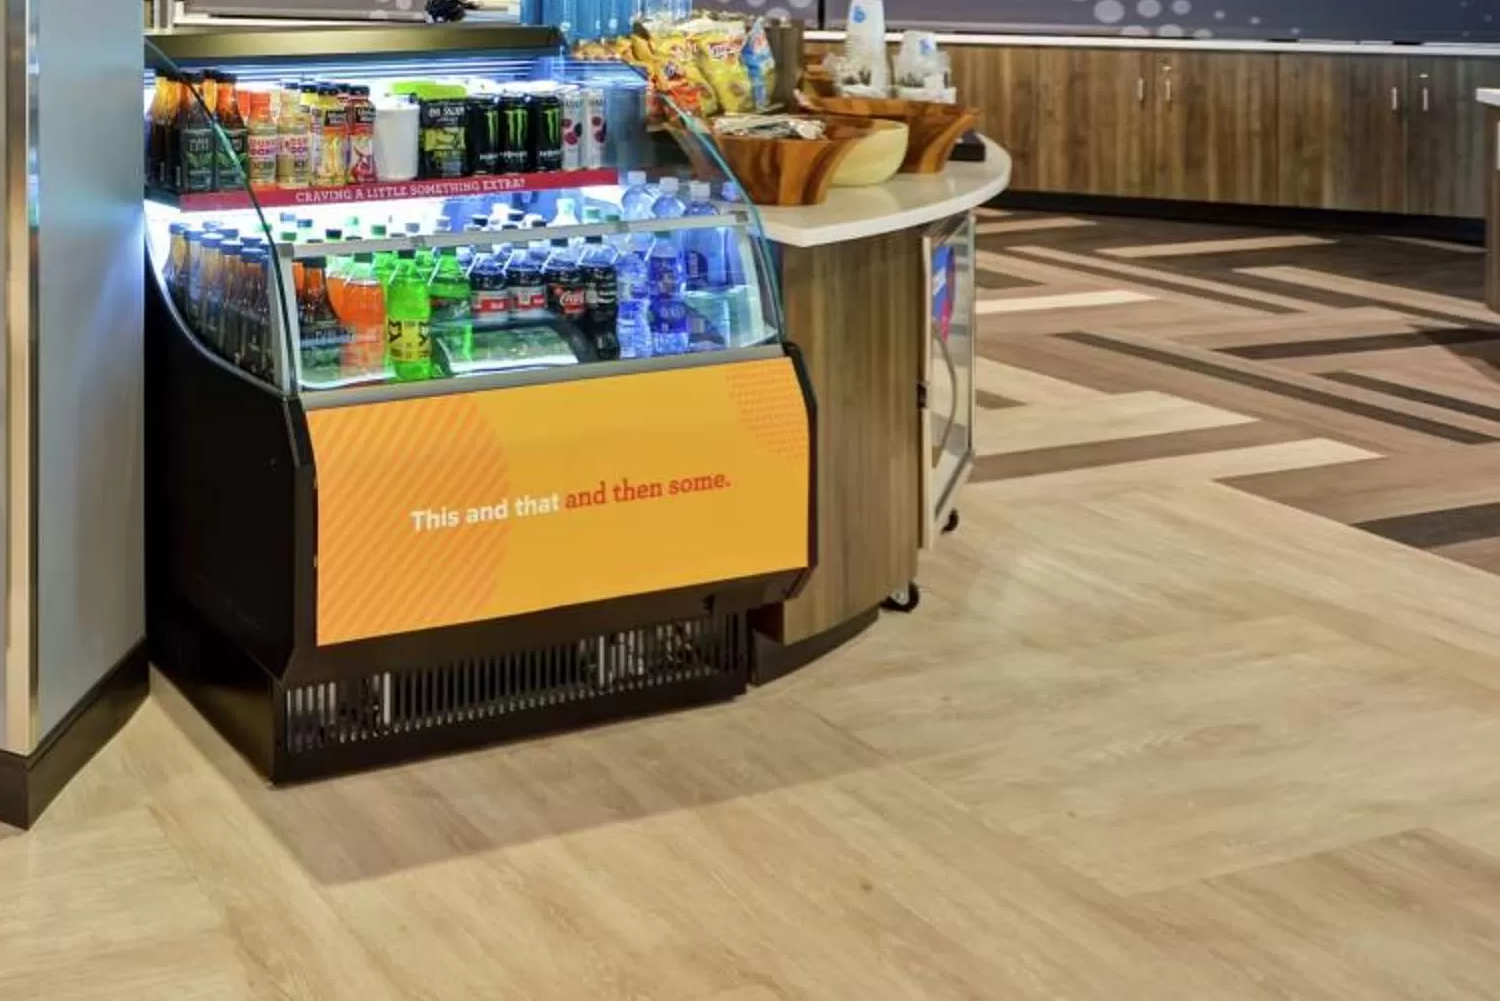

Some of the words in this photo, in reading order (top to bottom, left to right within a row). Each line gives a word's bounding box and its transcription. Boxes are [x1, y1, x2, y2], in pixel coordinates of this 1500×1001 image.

[295, 189, 351, 204] CRAVING
[355, 187, 364, 199] A
[367, 185, 406, 199] LITTLE
[410, 179, 479, 197] SOMETHING
[412, 508, 460, 532] This
[466, 499, 508, 524] and
[515, 493, 560, 518] that
[565, 481, 607, 509] and
[612, 476, 663, 504] then
[667, 472, 731, 497] some.
